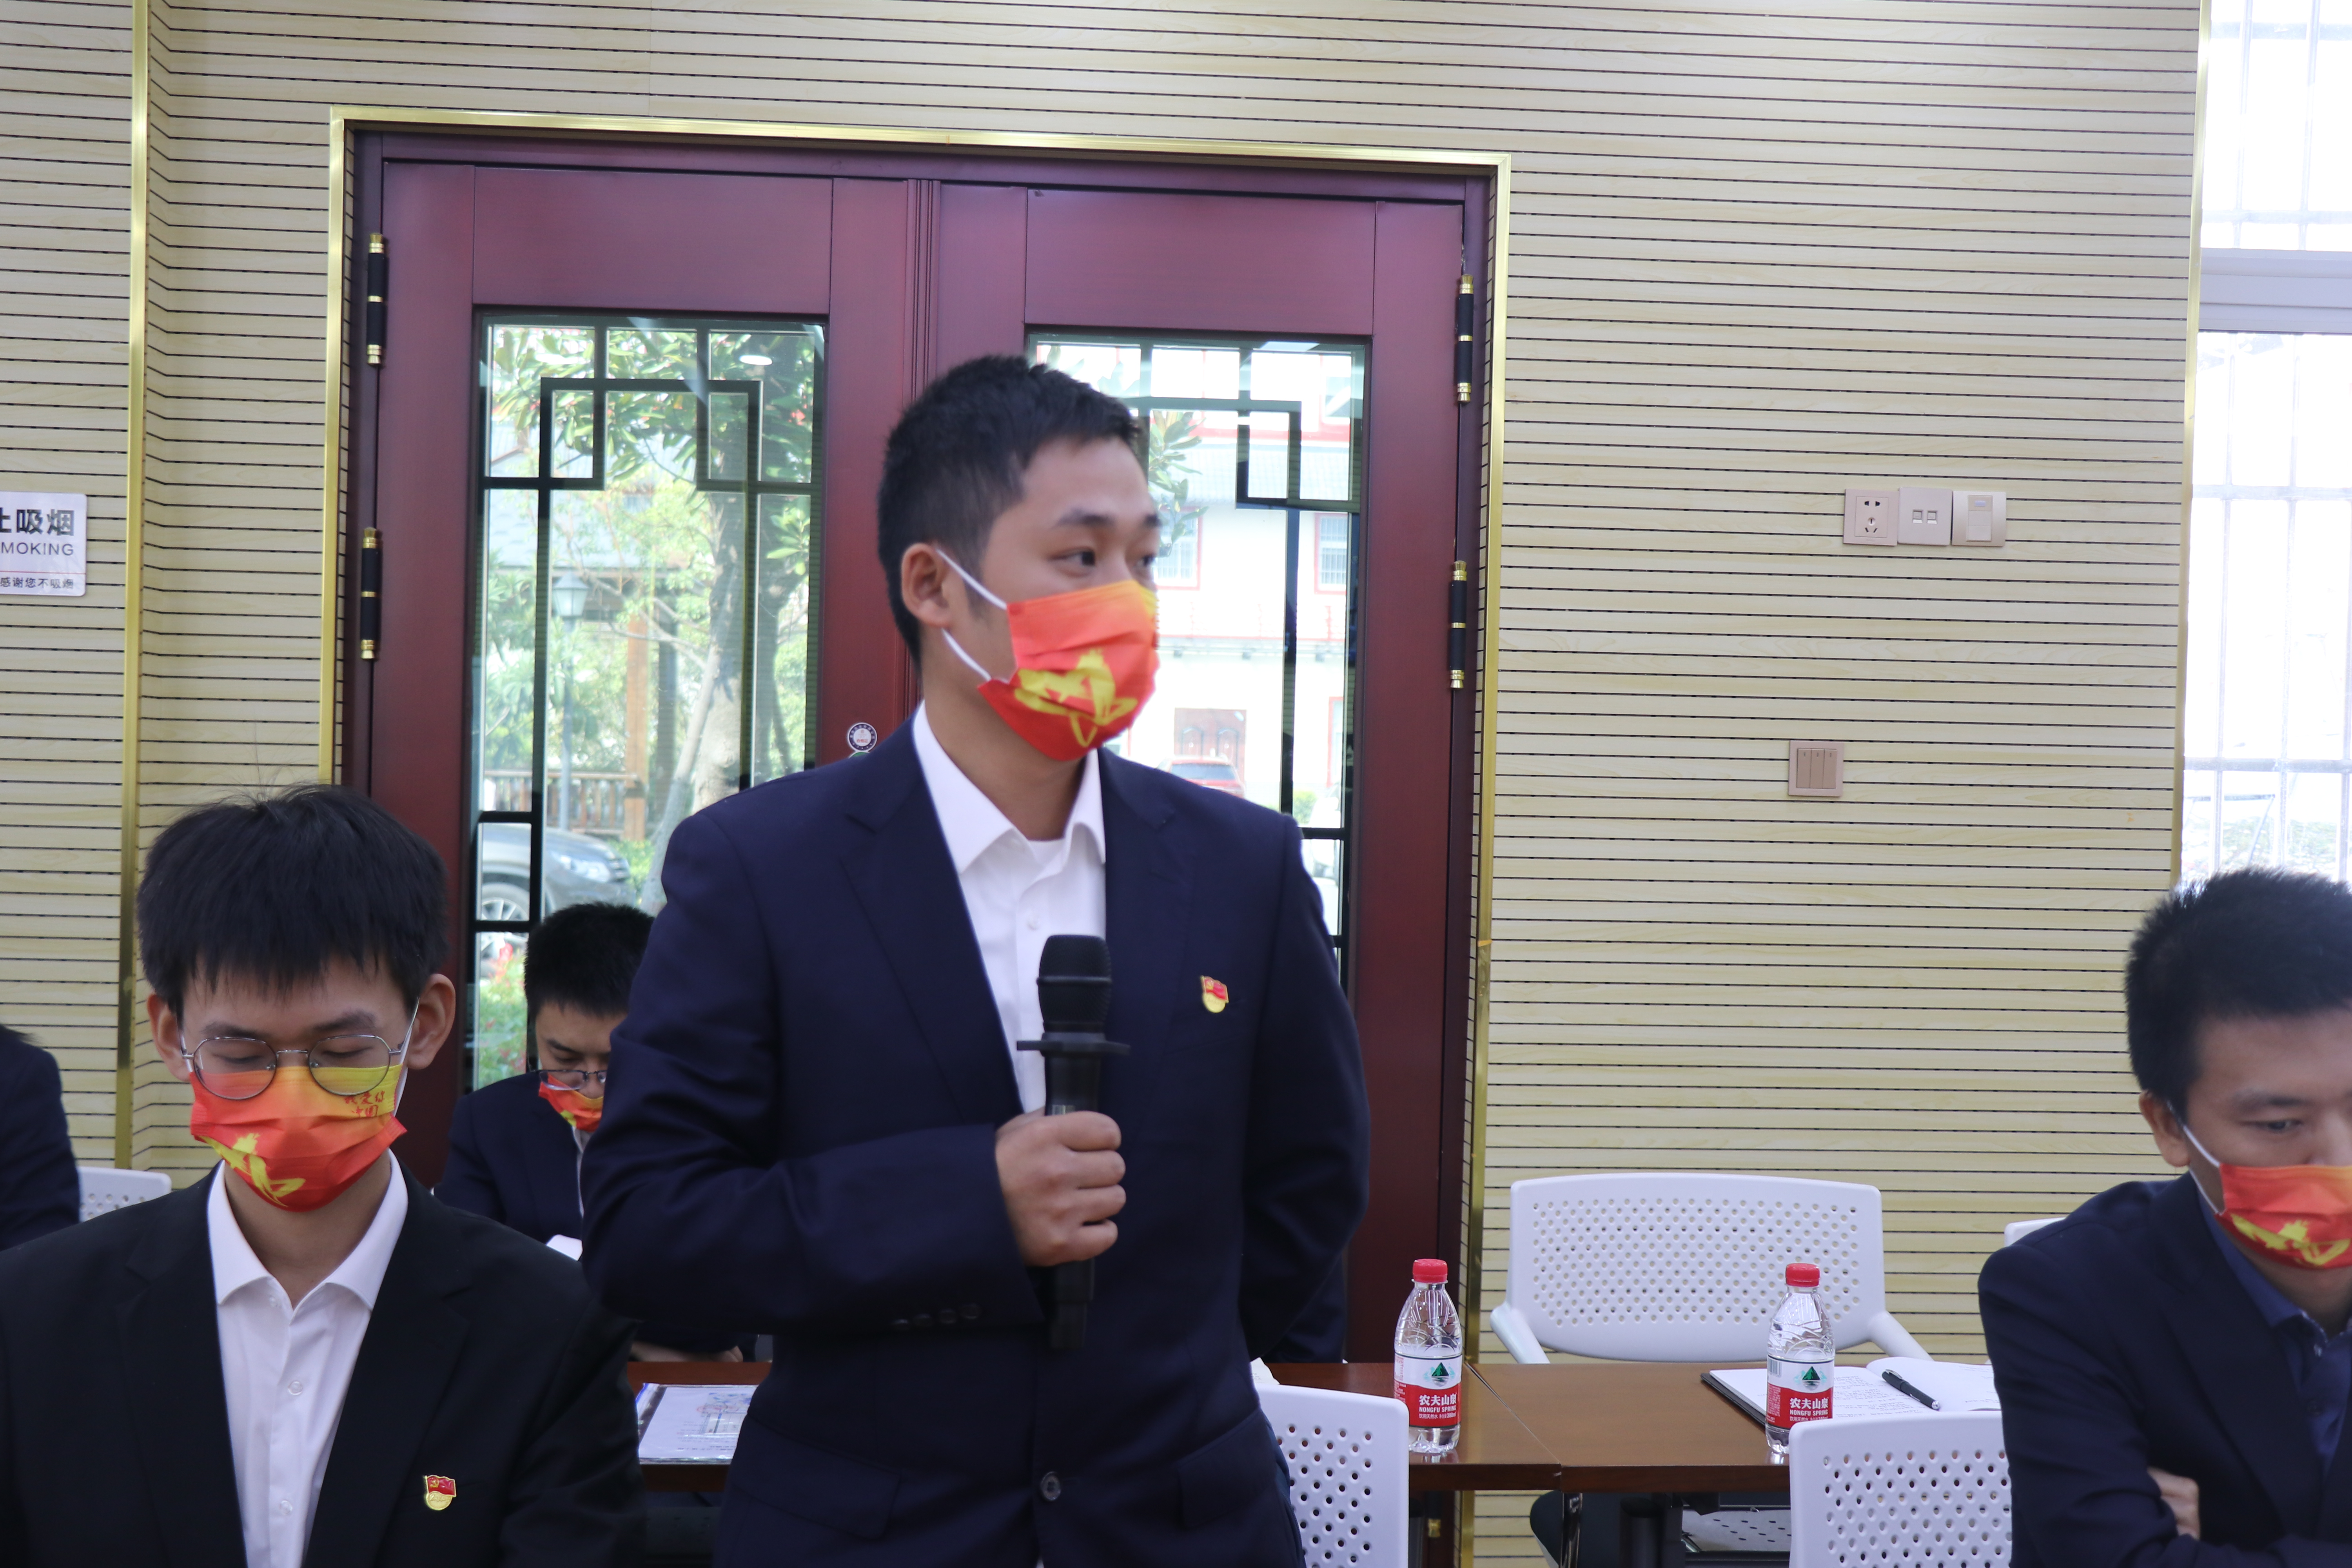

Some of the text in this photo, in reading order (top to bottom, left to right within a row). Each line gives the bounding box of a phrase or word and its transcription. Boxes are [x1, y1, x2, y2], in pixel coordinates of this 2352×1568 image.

[0, 577, 73, 589] 感谢您不吸烟
[1419, 1393, 1456, 1406] 农夫山泉
[1790, 1397, 1828, 1409] 农夫山泉
